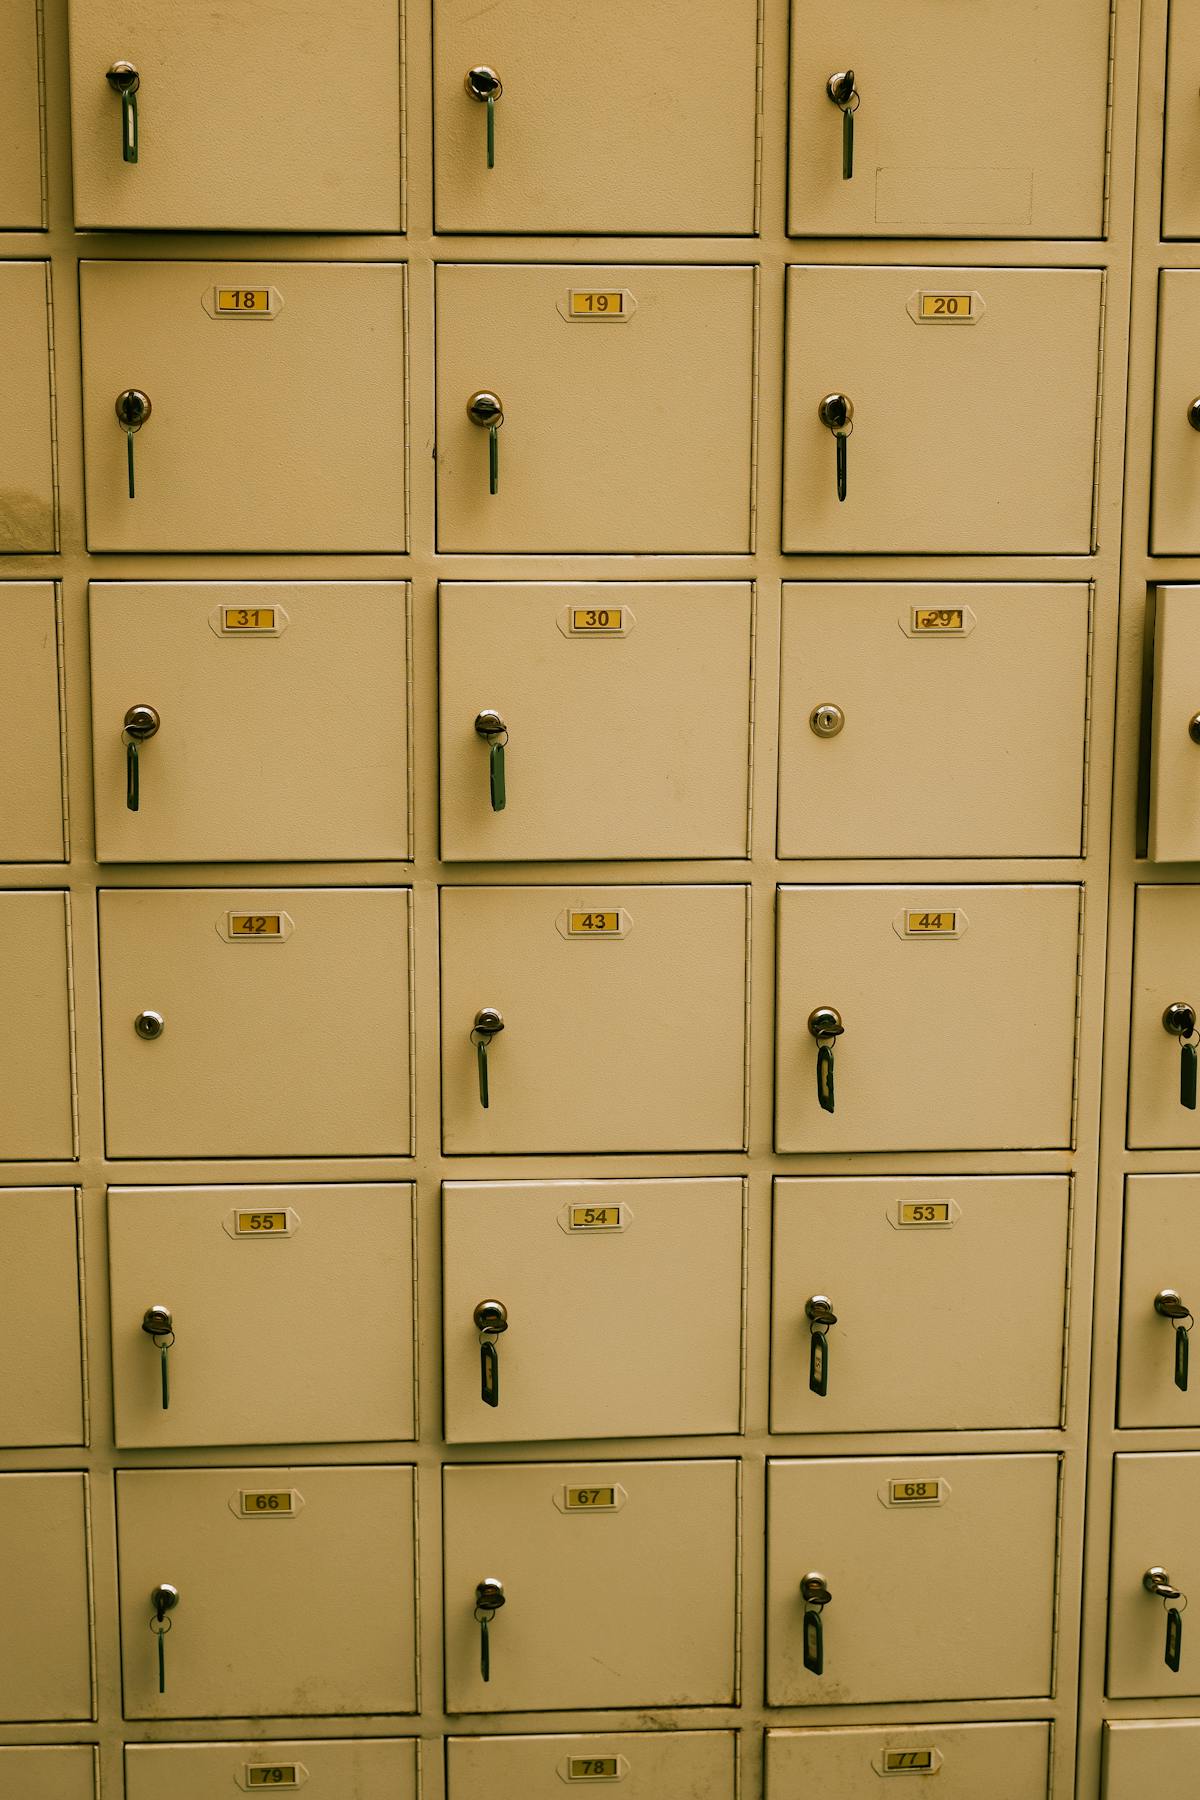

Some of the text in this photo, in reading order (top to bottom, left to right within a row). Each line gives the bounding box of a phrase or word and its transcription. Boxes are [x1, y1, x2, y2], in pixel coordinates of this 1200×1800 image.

[232, 291, 254, 308] 18
[585, 295, 608, 311] 19
[934, 298, 958, 313] 20
[238, 610, 259, 626] 31
[586, 611, 609, 626] 30
[928, 612, 950, 626] 29
[243, 917, 266, 932] 42
[582, 914, 605, 928] 43
[919, 914, 942, 928] 44
[584, 1209, 607, 1223] 54
[913, 1207, 934, 1220] 53
[250, 1216, 273, 1229] 55
[905, 1483, 926, 1496] 68
[256, 1496, 279, 1509] 66
[578, 1491, 600, 1504] 67
[898, 1753, 918, 1765] 77
[583, 1761, 603, 1774] 78
[261, 1770, 282, 1782] 79
